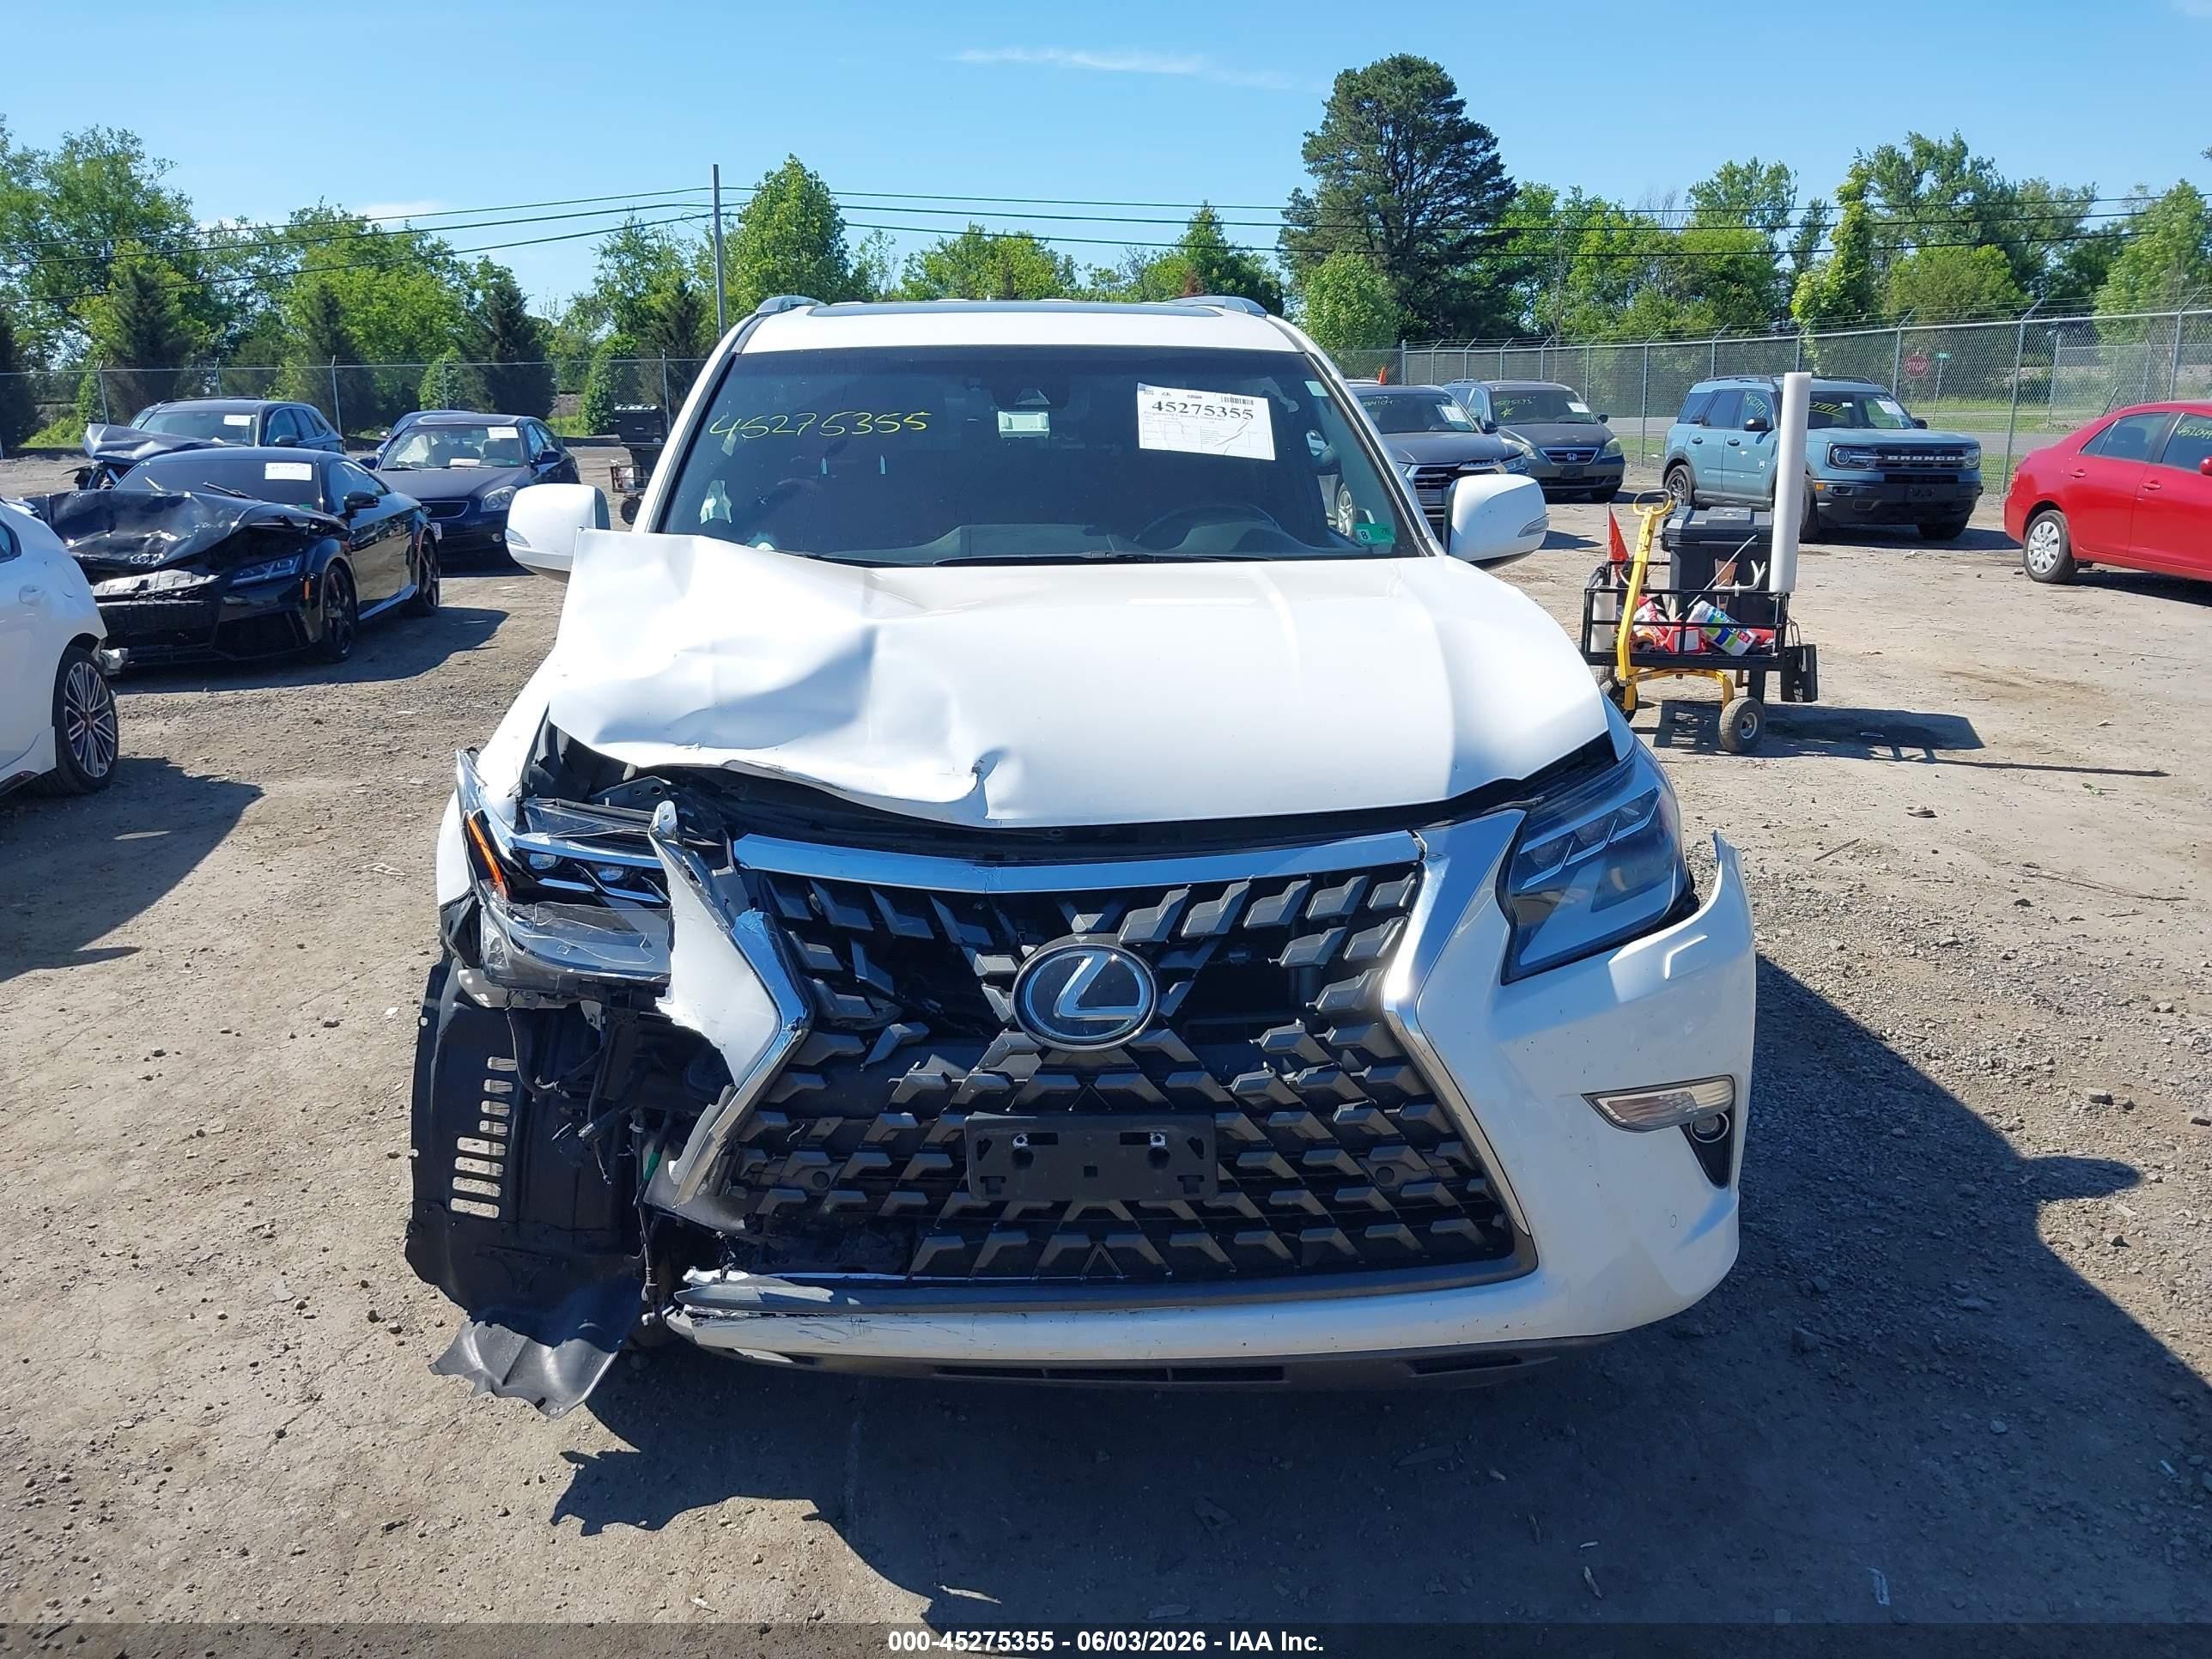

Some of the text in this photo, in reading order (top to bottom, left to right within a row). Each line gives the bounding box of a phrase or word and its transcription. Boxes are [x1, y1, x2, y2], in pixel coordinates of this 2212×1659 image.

[1152, 400, 1254, 420] 45275355
[709, 410, 932, 439] 45275355
[1360, 531, 1369, 540] 8
